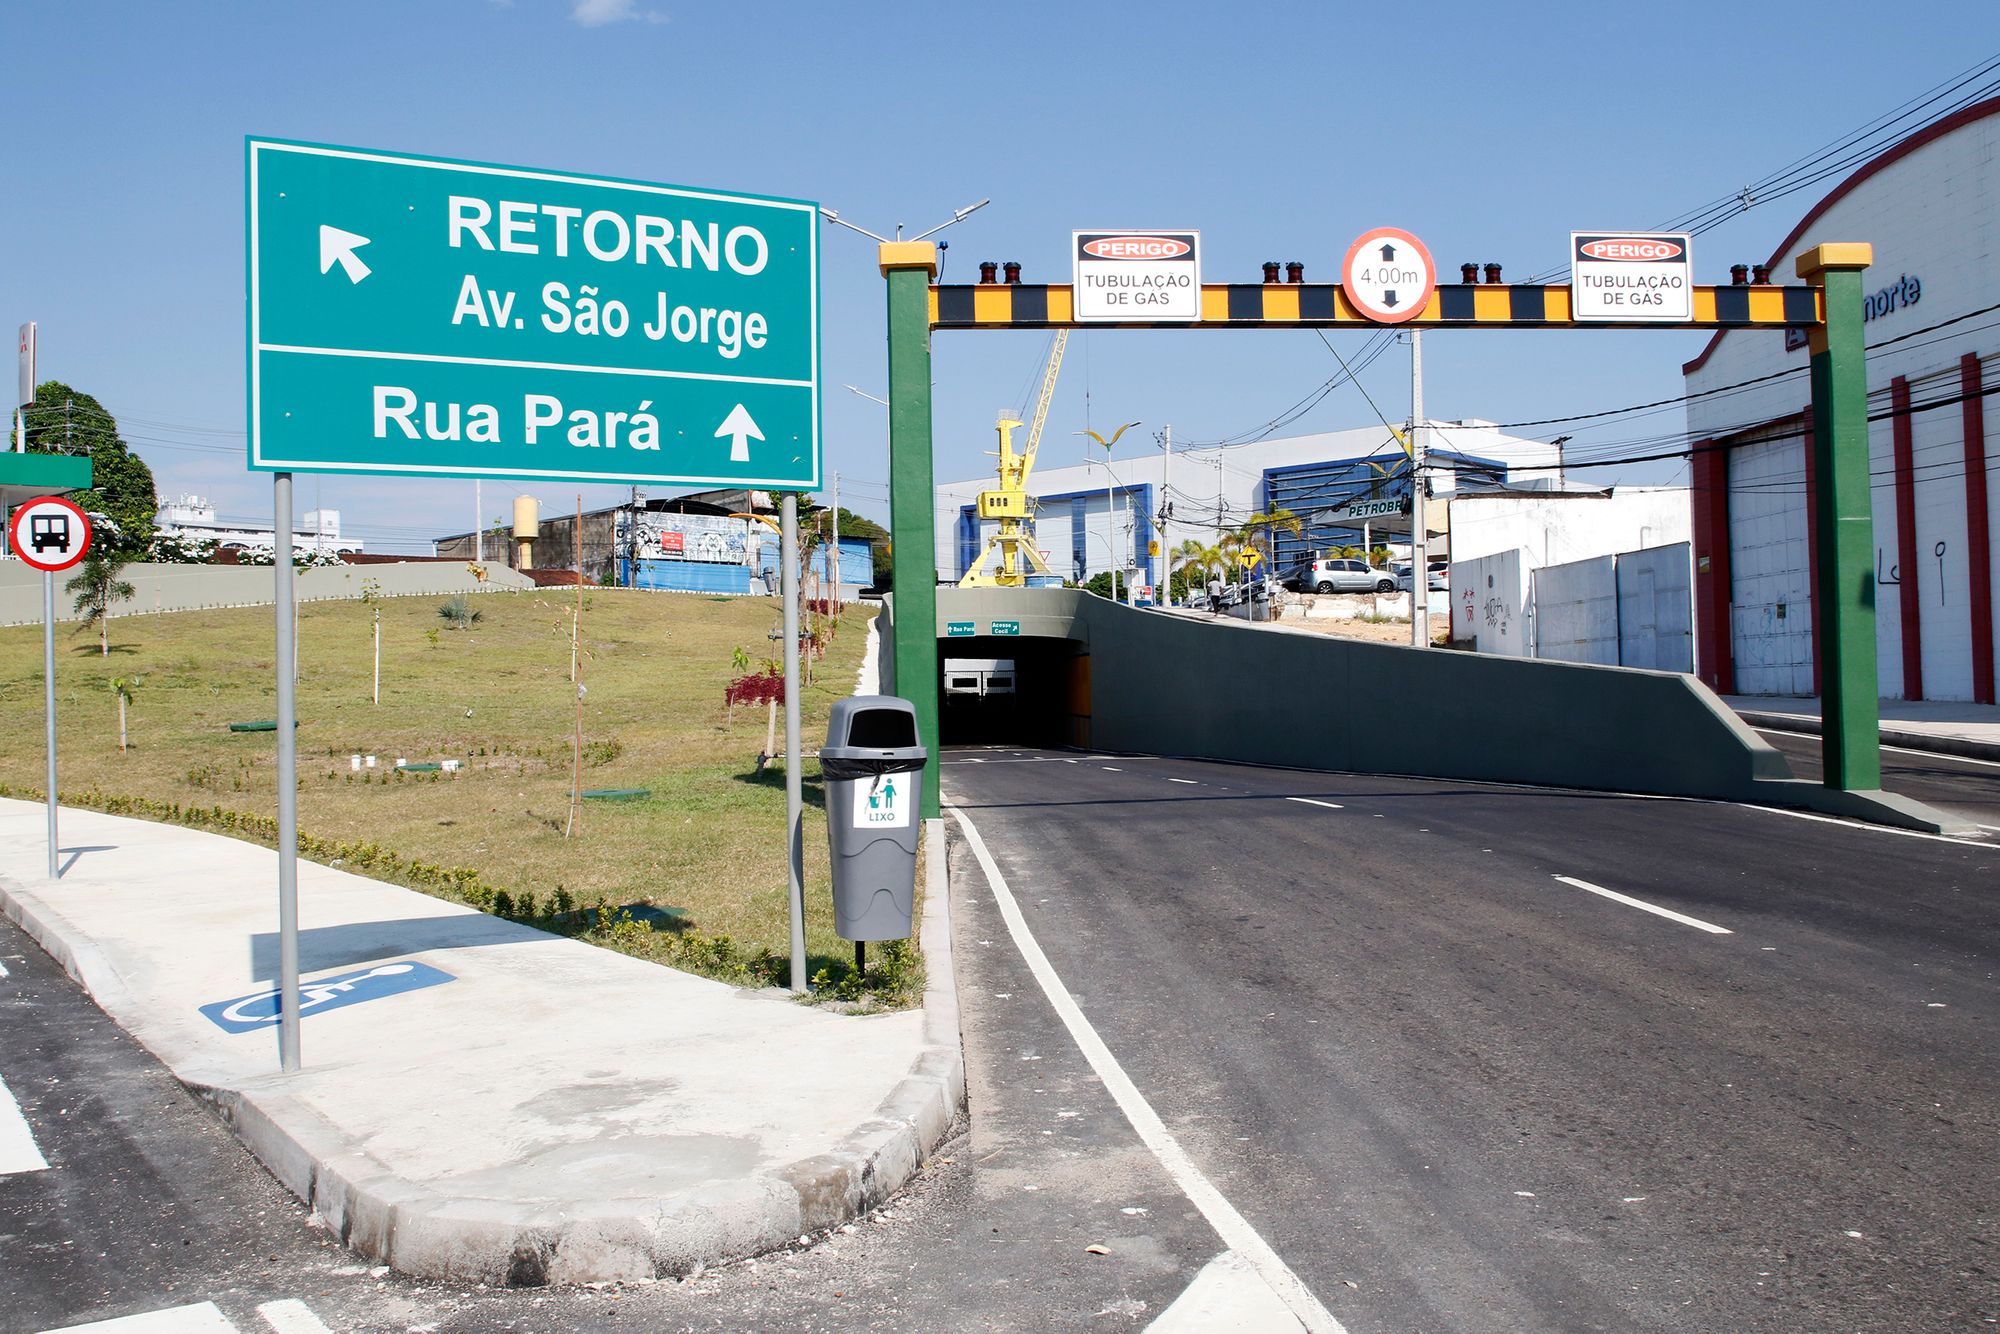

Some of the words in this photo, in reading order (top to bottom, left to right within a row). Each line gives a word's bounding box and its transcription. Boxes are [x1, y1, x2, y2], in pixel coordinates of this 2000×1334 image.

[448, 195, 769, 276] RETORNO
[1097, 243, 1179, 256] PERIGO
[1593, 244, 1671, 257] PERIGO
[1084, 272, 1190, 290] TUBULAÇÃO
[1361, 267, 1418, 286] 4,00m
[1583, 273, 1682, 291] TUBULAÇÃO
[1106, 292, 1129, 305] DE
[1134, 288, 1170, 305] GÁS
[1603, 292, 1625, 305] DE
[1629, 289, 1664, 305] GÁS
[451, 274, 524, 330] Av.
[541, 281, 630, 338] São
[643, 291, 768, 359] Jorge
[373, 385, 501, 443] Rua
[524, 394, 661, 451] Pará
[869, 813, 895, 821] LIXO
